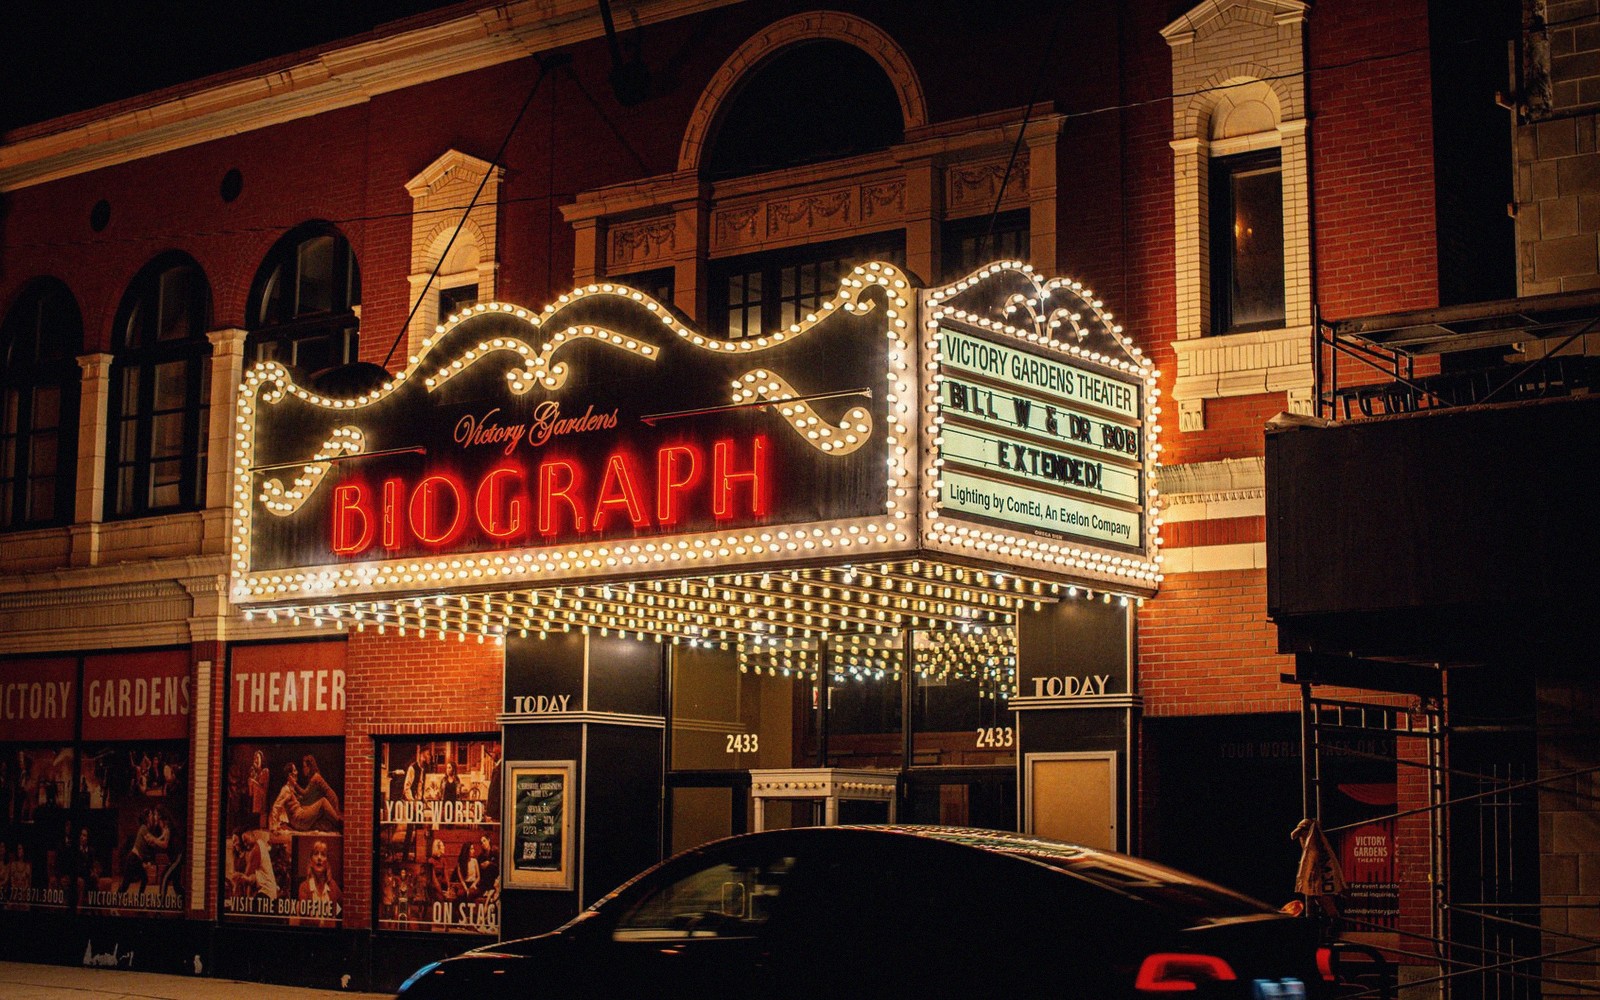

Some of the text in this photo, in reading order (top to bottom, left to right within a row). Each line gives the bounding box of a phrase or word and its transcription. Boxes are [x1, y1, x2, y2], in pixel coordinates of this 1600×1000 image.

[946, 334, 1132, 412] VICTORY GARDENS THEATER
[454, 401, 619, 456] Victory Gardens
[949, 381, 1137, 454] BILL W & DR BOB
[997, 440, 1103, 493] EXTENDED!
[331, 435, 768, 555] BIOGRAPH
[950, 484, 1131, 539] Lighting by ComEd, An Exelon Company
[88, 675, 191, 719] GARDENS
[236, 669, 346, 713] THEATER
[1032, 675, 1110, 697] TODAY
[513, 694, 571, 714] TODAY
[726, 734, 759, 753] 2433
[976, 727, 1013, 748] 2433
[1260, 740, 1301, 758] WORL
[386, 800, 483, 823] YOUR WORLD
[1354, 846, 1388, 857] GARDENS
[1355, 835, 1386, 846] VICTORY
[87, 889, 183, 909] VICTORYGARDENS.ORG
[230, 896, 333, 916] VISIT THE BOX OFFICE
[433, 901, 496, 925] ON STAG
